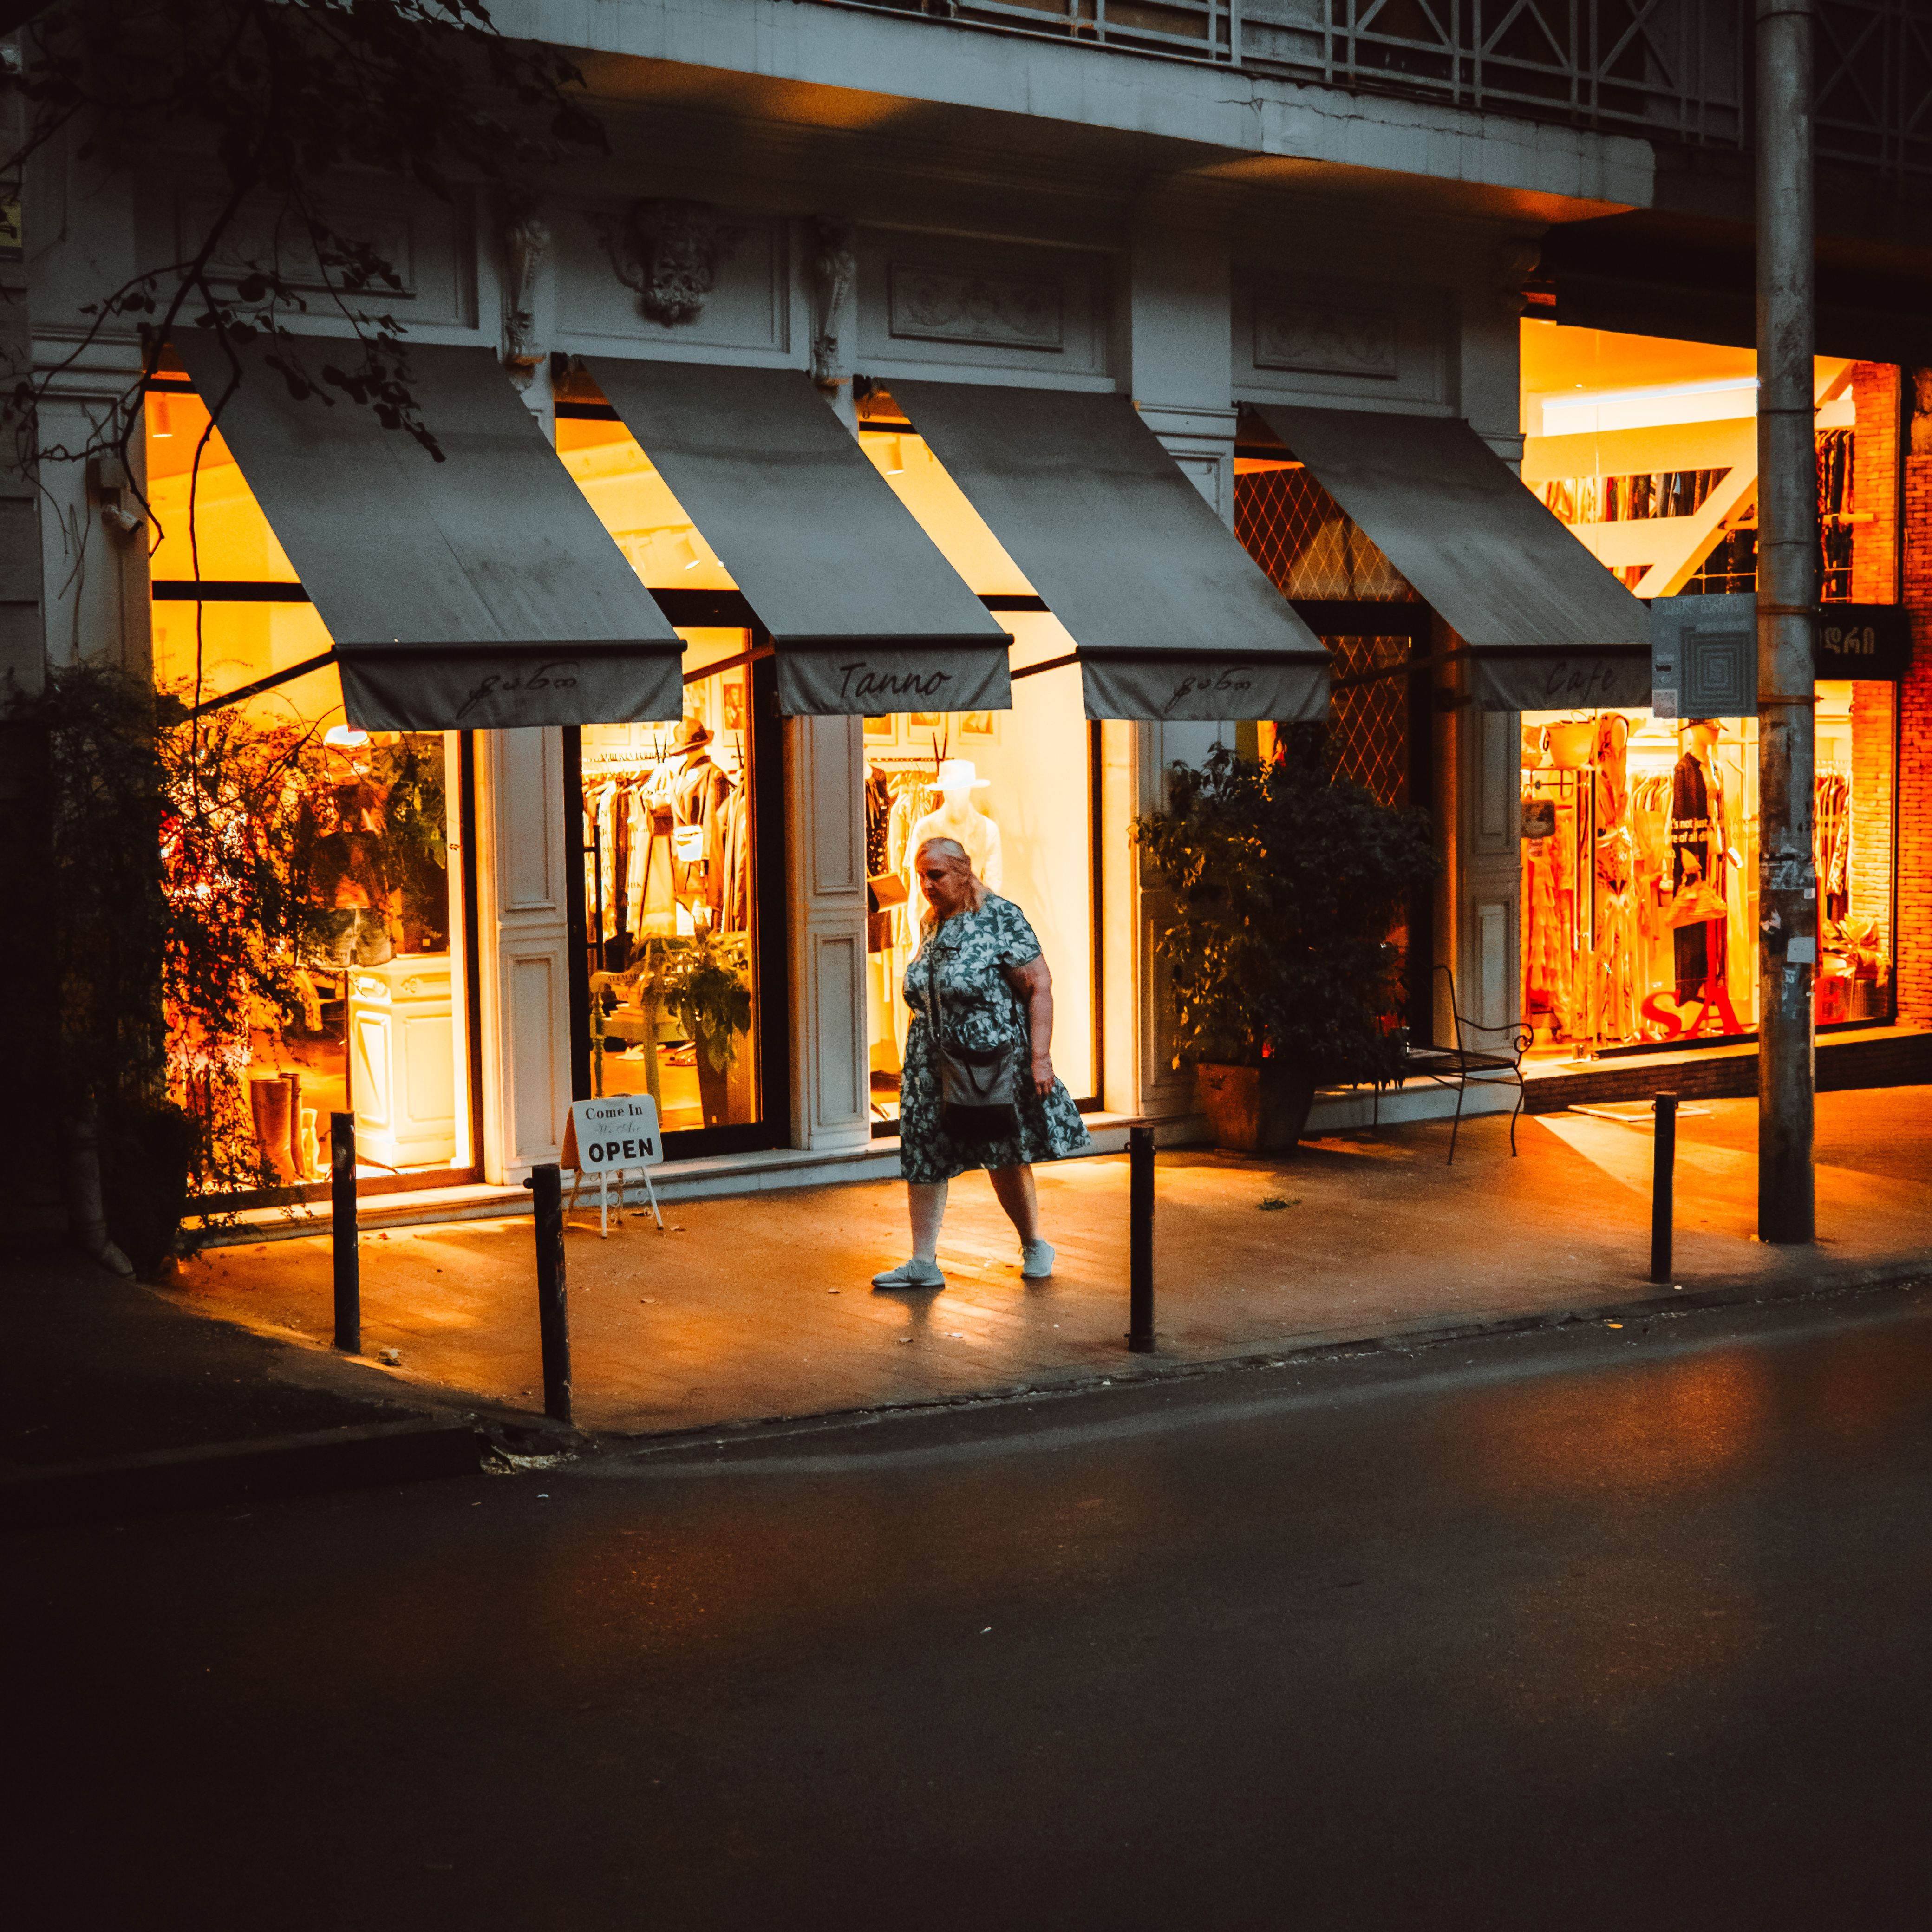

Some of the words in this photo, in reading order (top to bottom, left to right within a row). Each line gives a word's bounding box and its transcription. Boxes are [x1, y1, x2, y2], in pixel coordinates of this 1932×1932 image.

[840, 661, 951, 698] Tanno
[1546, 660, 1617, 702] Cafe
[1679, 818, 1693, 829] not
[1679, 831, 1688, 842] of
[1689, 830, 1697, 842] all
[586, 1108, 624, 1120] Come
[628, 1104, 642, 1116] In
[588, 1137, 653, 1162] OPEN
